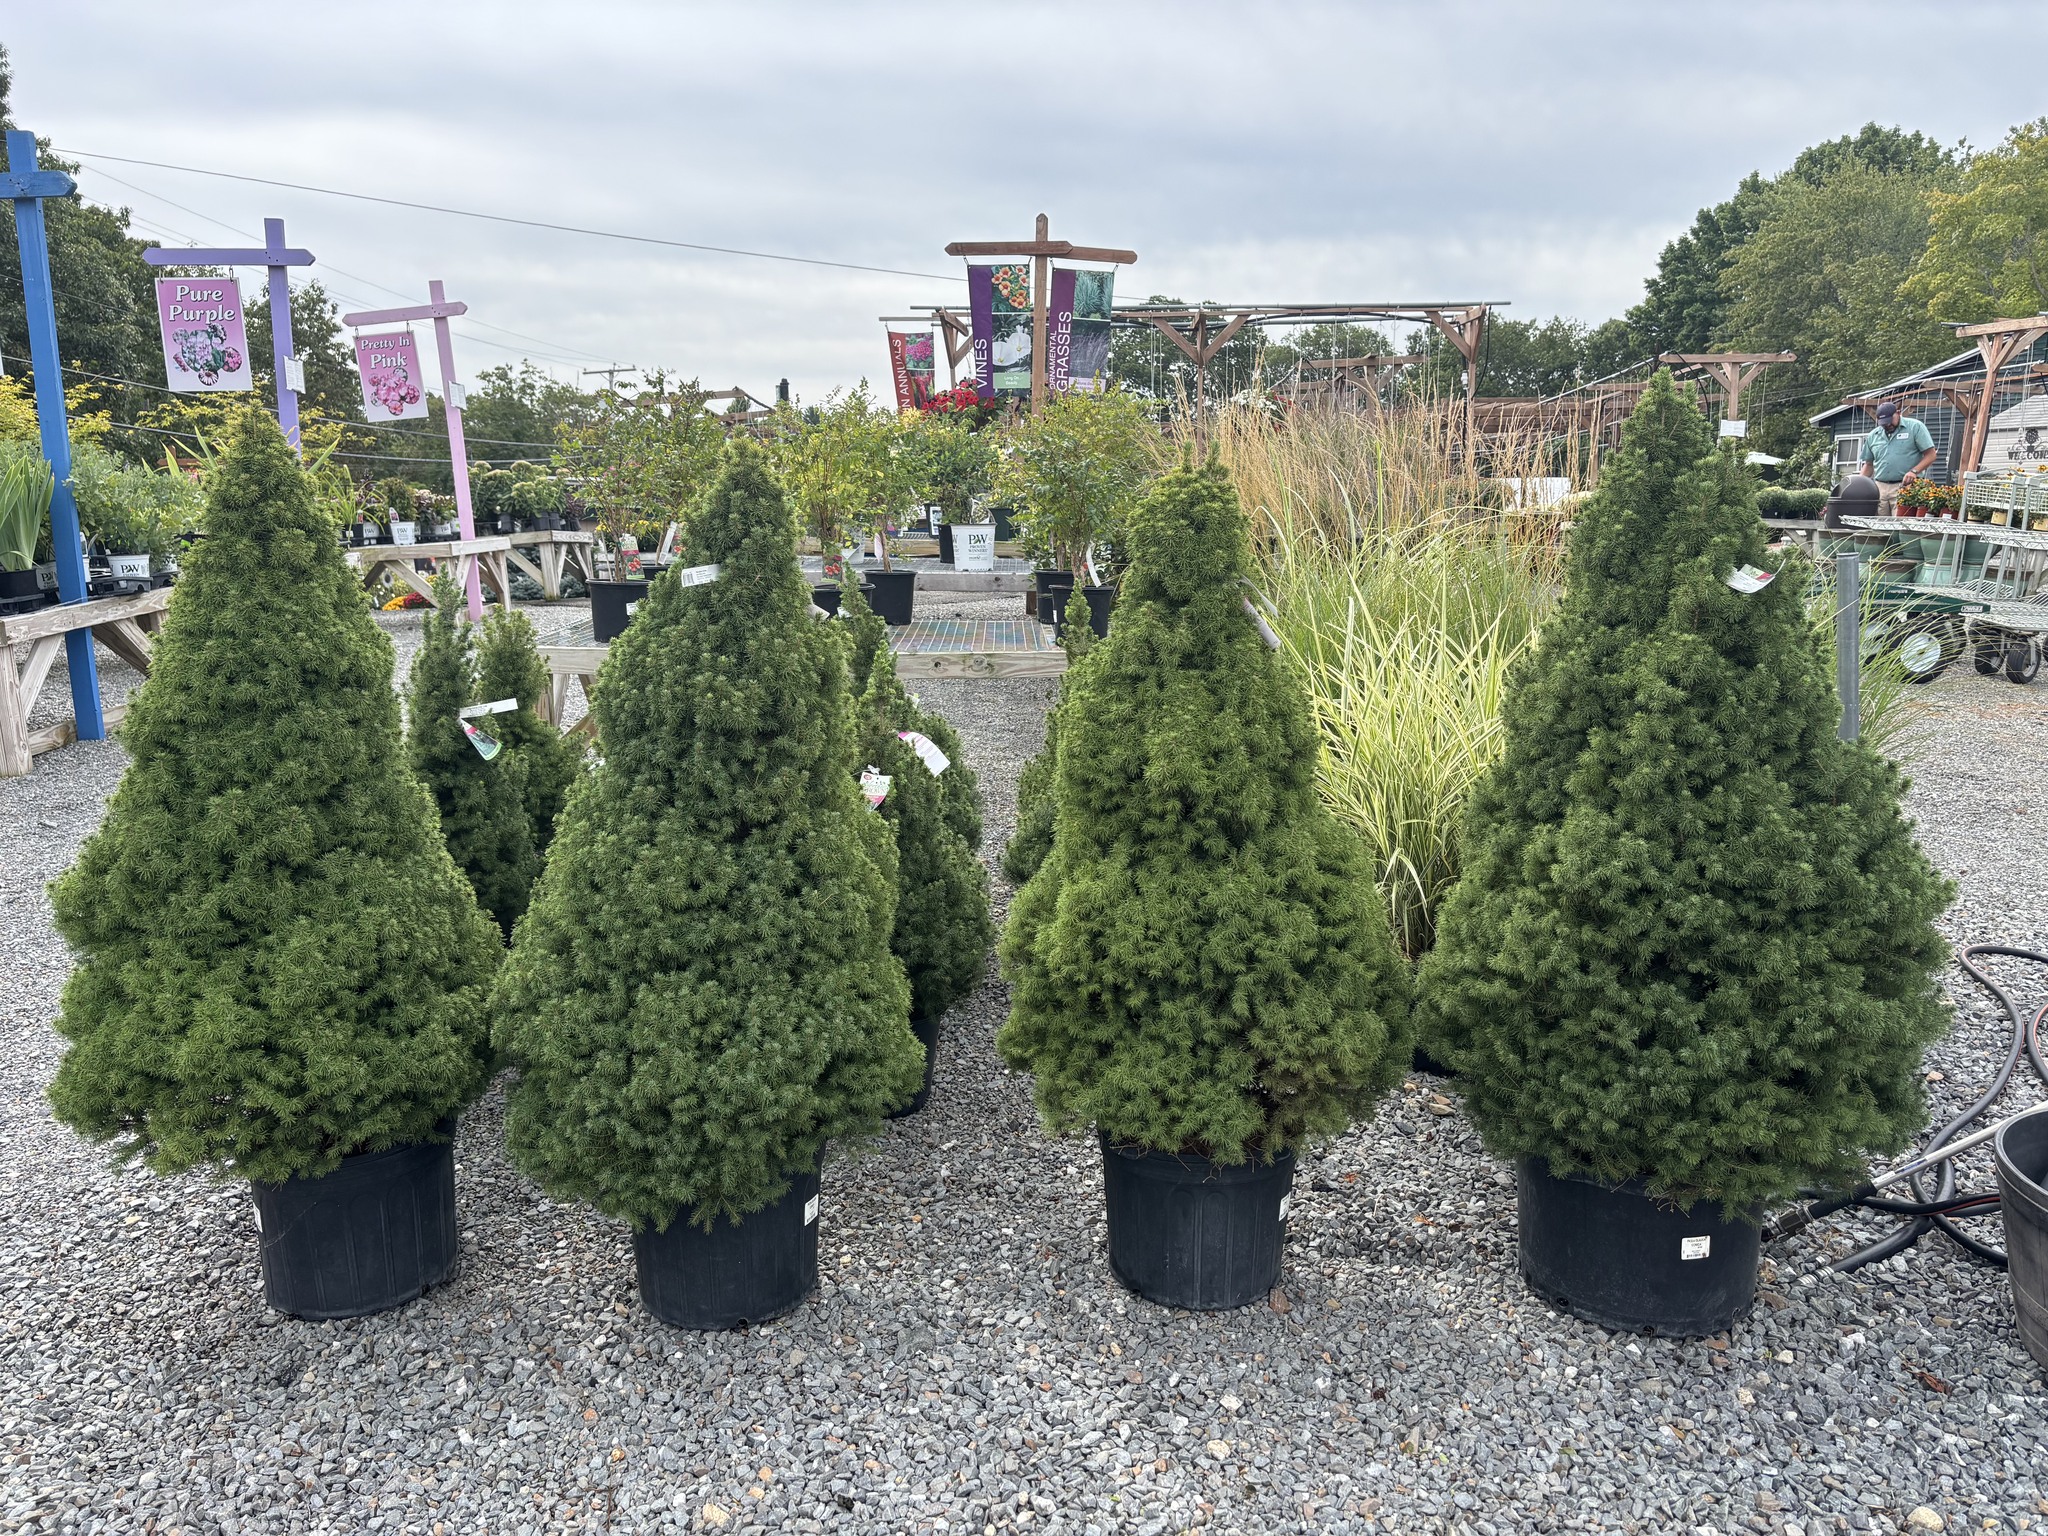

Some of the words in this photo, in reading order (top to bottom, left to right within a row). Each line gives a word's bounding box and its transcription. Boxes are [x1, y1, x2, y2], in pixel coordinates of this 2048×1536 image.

[176, 285, 223, 302] Pure
[169, 304, 236, 325] Purple
[361, 339, 395, 351] Pretty
[399, 336, 410, 347] In
[370, 352, 407, 369] Pink
[1049, 330, 1057, 390] ORNAMENTAL
[1056, 311, 1072, 393] GRASSES
[892, 339, 910, 396] ANNUALS
[974, 338, 988, 389] VINES
